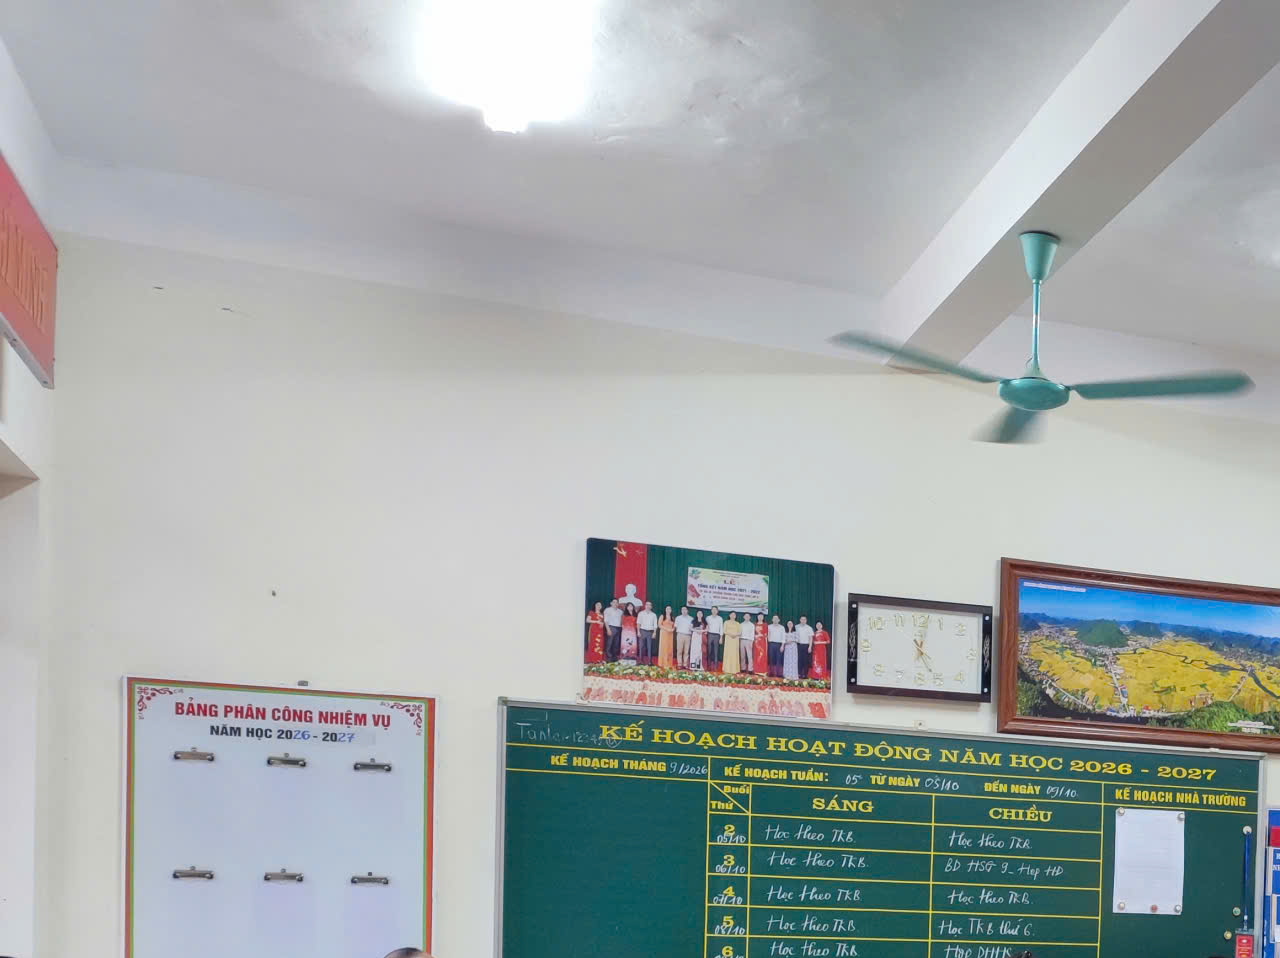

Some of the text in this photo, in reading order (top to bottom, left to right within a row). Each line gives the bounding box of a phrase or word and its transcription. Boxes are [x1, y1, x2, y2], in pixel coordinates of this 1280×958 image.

[175, 697, 391, 731] BẢNG PHÂN CÔNG NHIỆM VỤ
[210, 723, 355, 743] NĂM HỌC 2026 2027
[600, 720, 644, 742] KẾ
[651, 728, 757, 750] HOẠCH
[766, 737, 846, 757] HOẠT
[854, 741, 931, 761] ĐỘNG
[940, 748, 1002, 766] NĂM
[1009, 754, 1063, 772] HỌC
[1070, 760, 1132, 775] 2026
[1157, 766, 1216, 781] 2027
[551, 752, 708, 775] KẾ HOẠCH THÁNG 9/2026
[723, 784, 749, 794] Buổi
[724, 763, 742, 777] KẾ
[745, 768, 787, 781] HOẠCH
[791, 768, 829, 782] TUẦN:
[870, 773, 887, 785] TỪ
[888, 775, 920, 787] NGÀY
[984, 780, 1007, 793] ĐẾN
[1011, 782, 1041, 795] NGÀY
[711, 800, 734, 810] Thứ
[812, 794, 874, 813] SÁNG
[1115, 787, 1246, 807] KẾ HOẠCH NHÀ TRƯỜNG
[989, 804, 1052, 822] CHIỀU
